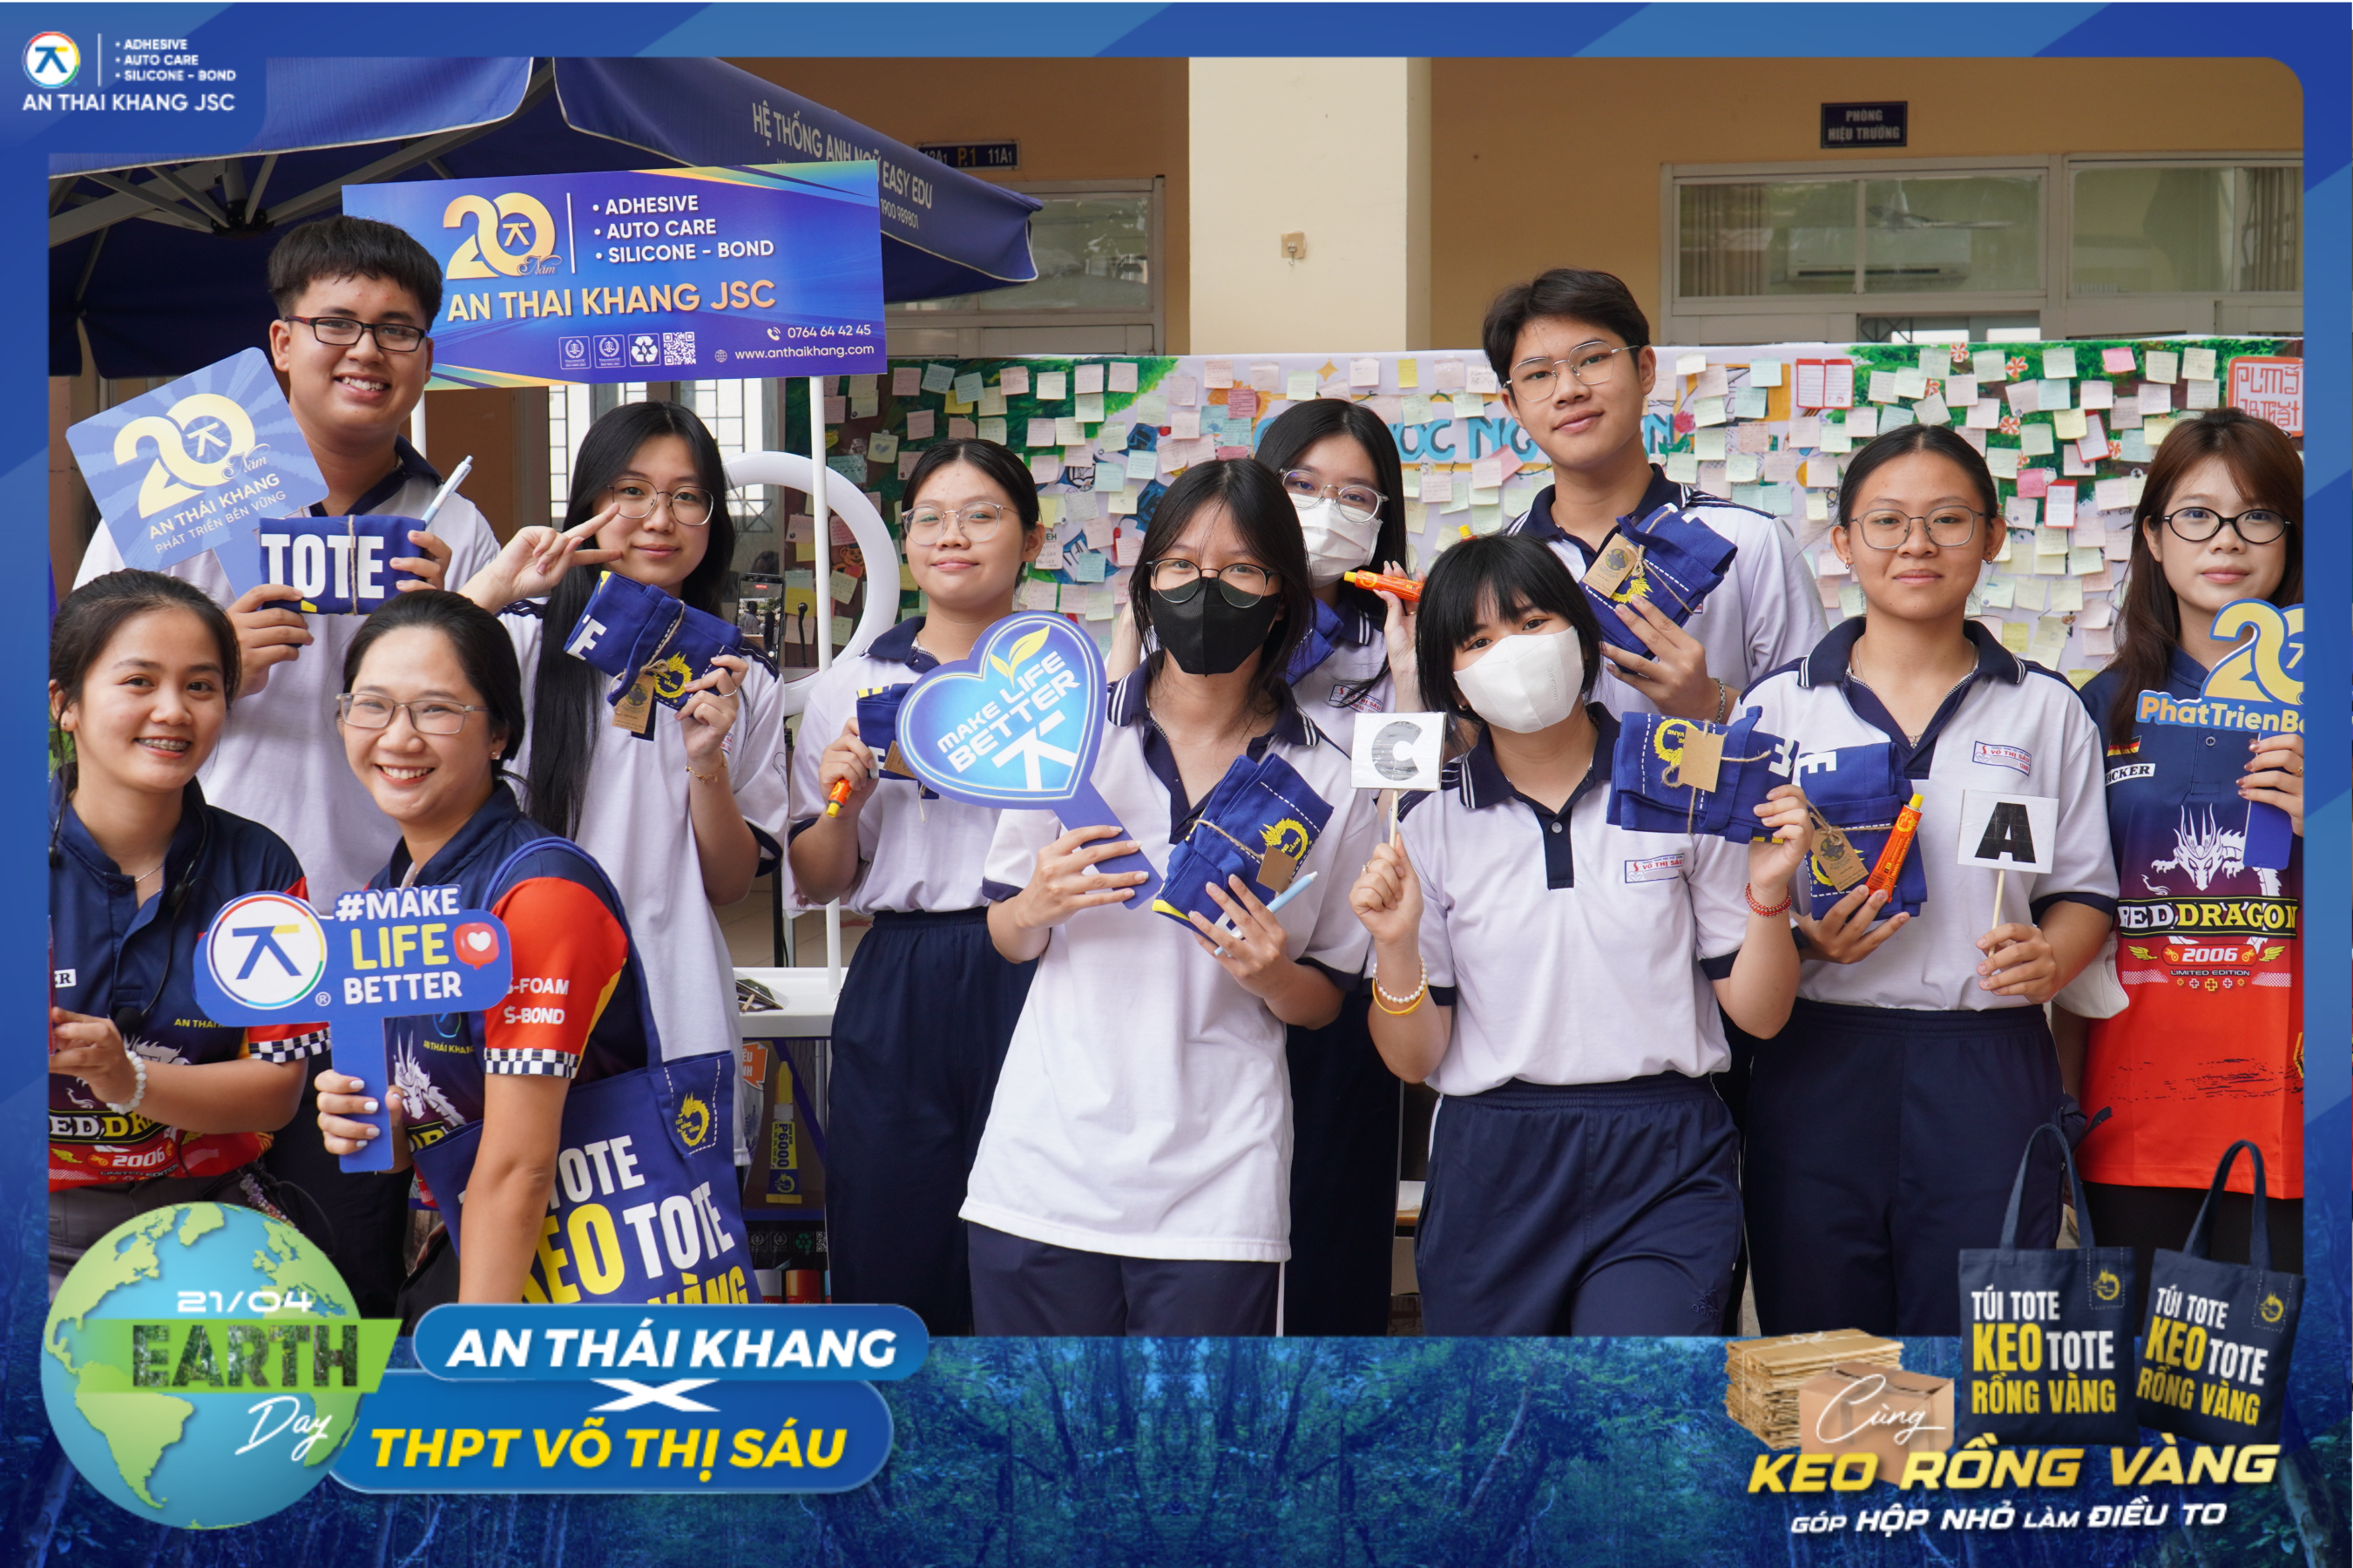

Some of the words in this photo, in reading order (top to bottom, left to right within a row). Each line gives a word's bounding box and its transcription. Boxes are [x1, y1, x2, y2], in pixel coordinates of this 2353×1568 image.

[752, 100, 772, 146] HỆ
[773, 111, 823, 159] THỐNG
[826, 137, 851, 162] ANH
[882, 162, 909, 198] EASY
[912, 176, 933, 209] EDU
[958, 146, 976, 166] P.1
[988, 148, 1012, 164] 11A1
[605, 194, 698, 215] ADHESIVE
[880, 198, 896, 220] 1900
[607, 221, 659, 240] AUTO
[665, 218, 716, 237] CARE
[608, 244, 696, 263] SILICONE
[718, 240, 774, 259] BOND
[447, 293, 490, 321] AN
[499, 288, 571, 318] THAI
[582, 283, 700, 314] KHANG
[710, 279, 776, 309] JSC
[788, 327, 817, 339] 0764
[820, 326, 835, 338] 64
[838, 325, 854, 337] 42
[856, 324, 871, 336] 45
[734, 344, 875, 360] www.anthaikhang.com
[221, 443, 270, 480] Năm
[150, 518, 174, 539] AN
[174, 500, 217, 526] THÁI
[219, 473, 281, 508] KHANG
[155, 535, 186, 554] PHÁT
[261, 533, 384, 598] TOTE
[936, 700, 1001, 754] MAKE
[999, 651, 1065, 704] LIFE
[947, 669, 1080, 773] BETTER
[1371, 720, 1423, 781] C
[2004, 750, 2017, 759] THỊ
[1974, 801, 2037, 863] A
[335, 887, 461, 922] #MAKE
[351, 923, 449, 970] LIFE
[2182, 948, 2239, 963] 2006
[344, 971, 463, 1004] BETTER
[174, 1018, 190, 1027] AN
[504, 1005, 565, 1024] S-BOND
[430, 1042, 447, 1052] THÁI
[449, 1044, 475, 1054] KHAN
[49, 1115, 100, 1136] ED
[112, 1146, 166, 1166] 2006
[777, 1123, 789, 1168] P6000
[550, 1135, 646, 1209] OTE
[522, 1203, 625, 1303] EO
[623, 1181, 735, 1280] TOTE
